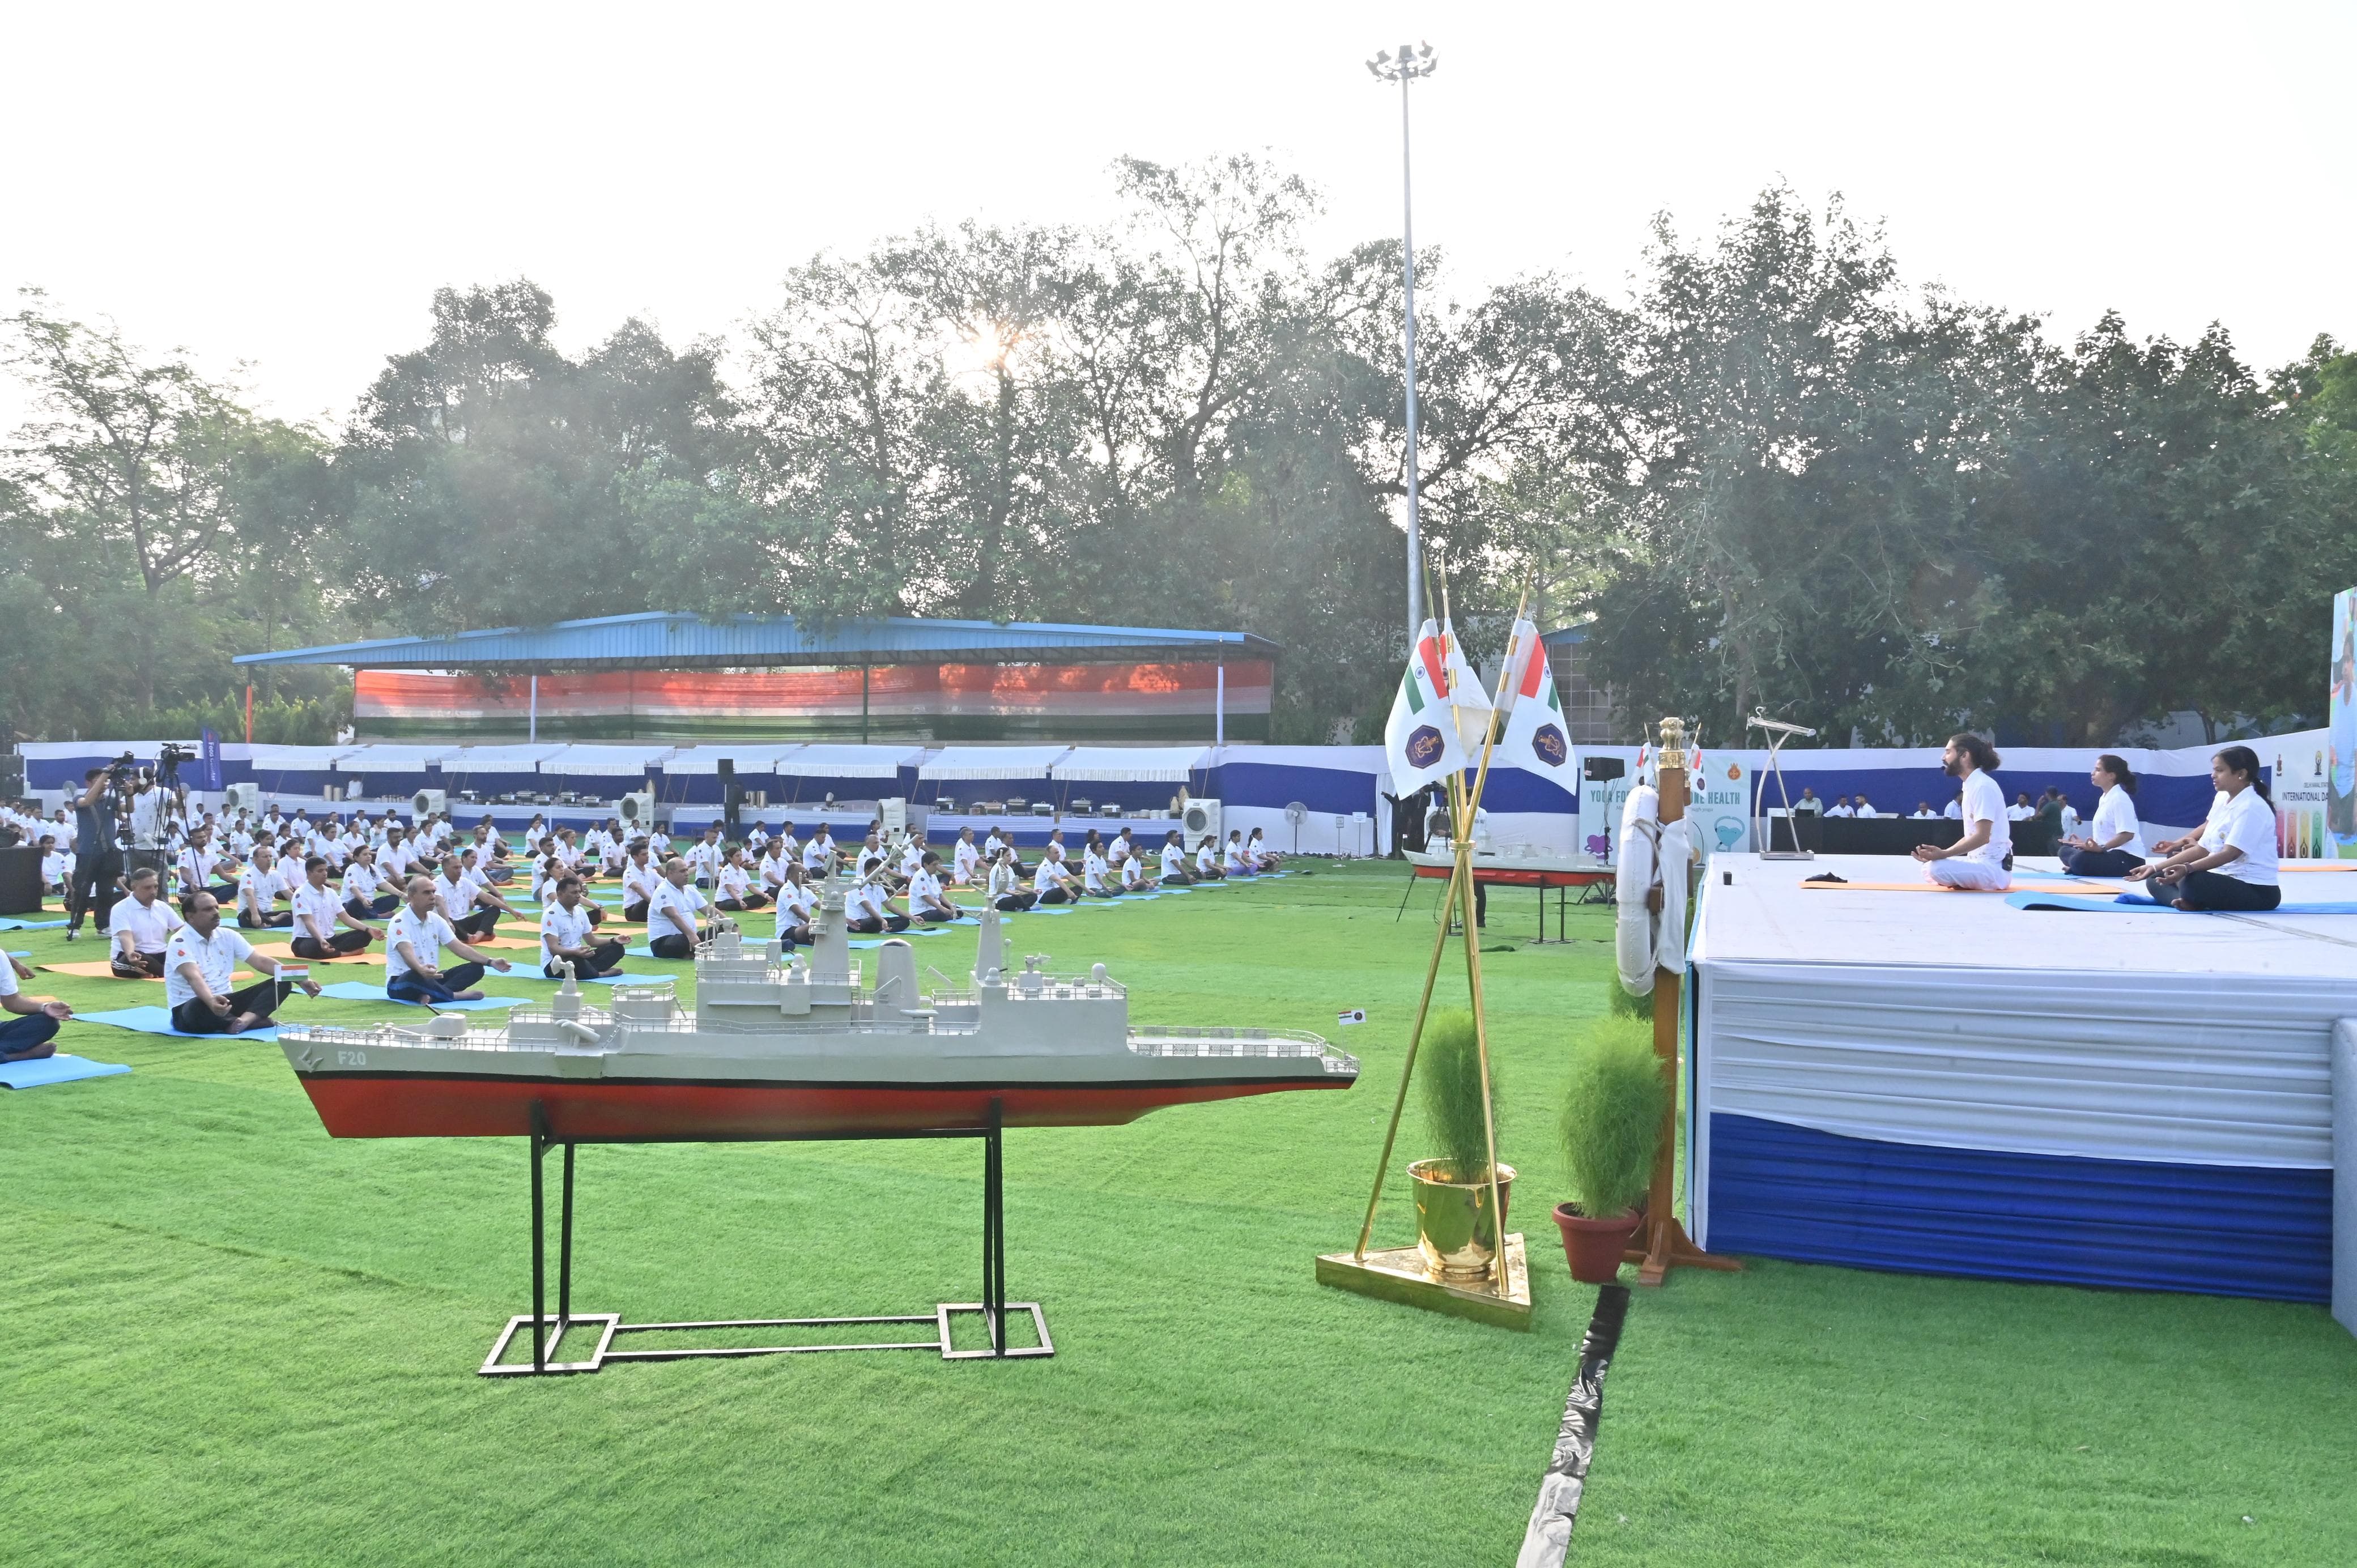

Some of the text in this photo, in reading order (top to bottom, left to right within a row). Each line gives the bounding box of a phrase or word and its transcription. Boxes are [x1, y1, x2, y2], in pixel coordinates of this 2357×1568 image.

[1591, 790, 1612, 802] YOGA
[1708, 792, 1740, 804] HEALTH
[2282, 792, 2320, 801] INTERNATIONAL
[337, 1050, 367, 1066] F20
